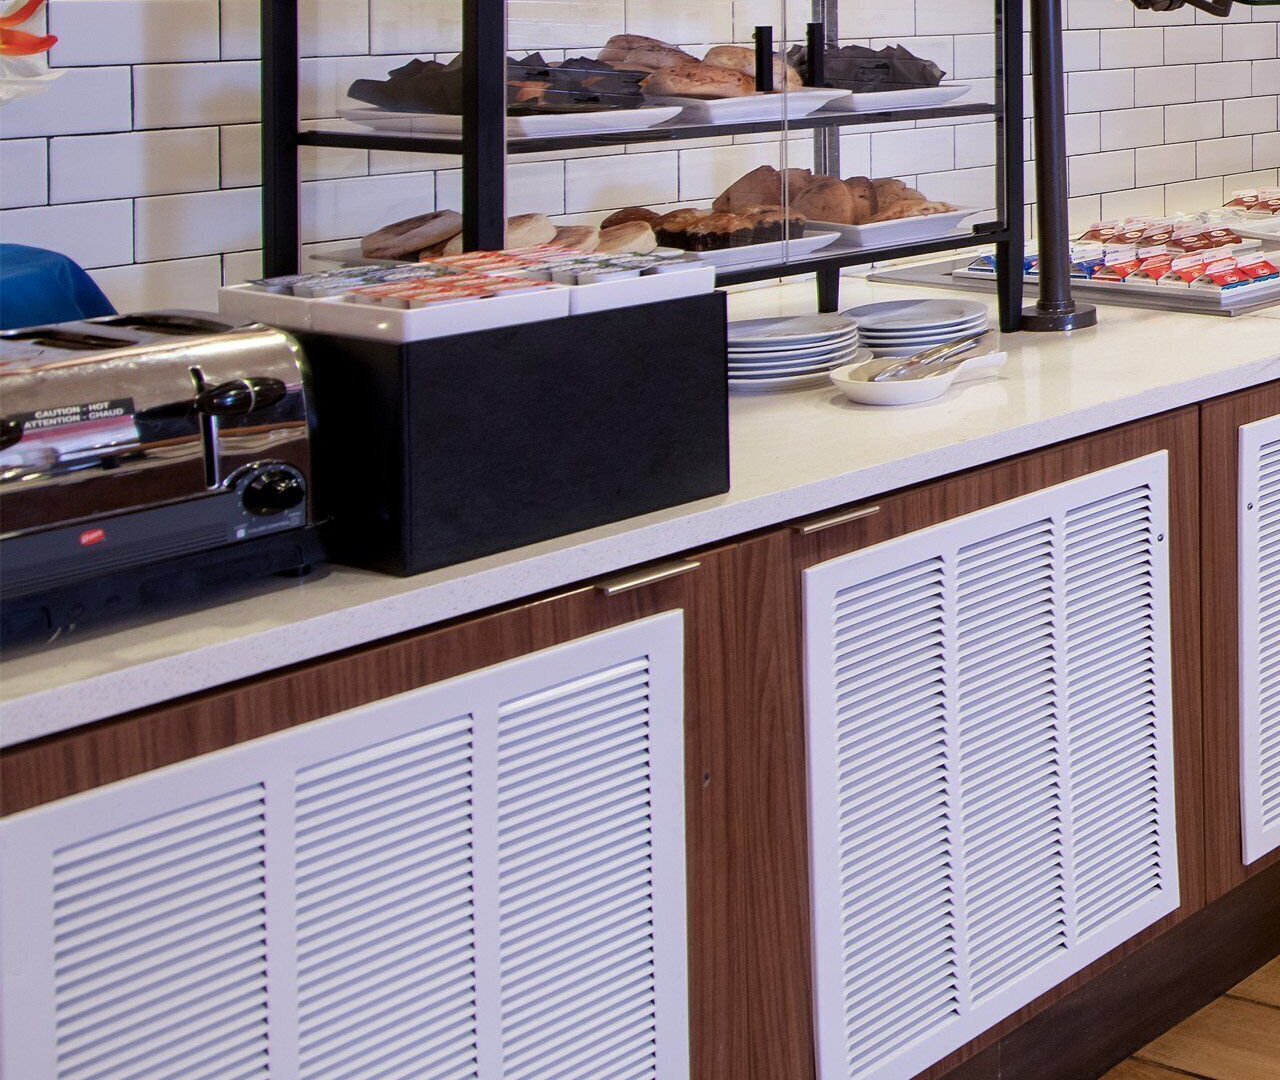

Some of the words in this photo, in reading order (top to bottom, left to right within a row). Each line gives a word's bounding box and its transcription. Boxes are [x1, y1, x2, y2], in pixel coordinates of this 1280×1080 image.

[24, 415, 80, 429] ATTENTION
[88, 408, 123, 419] CHAUD
[34, 406, 80, 419] CAUTION
[88, 402, 109, 411] HOT
